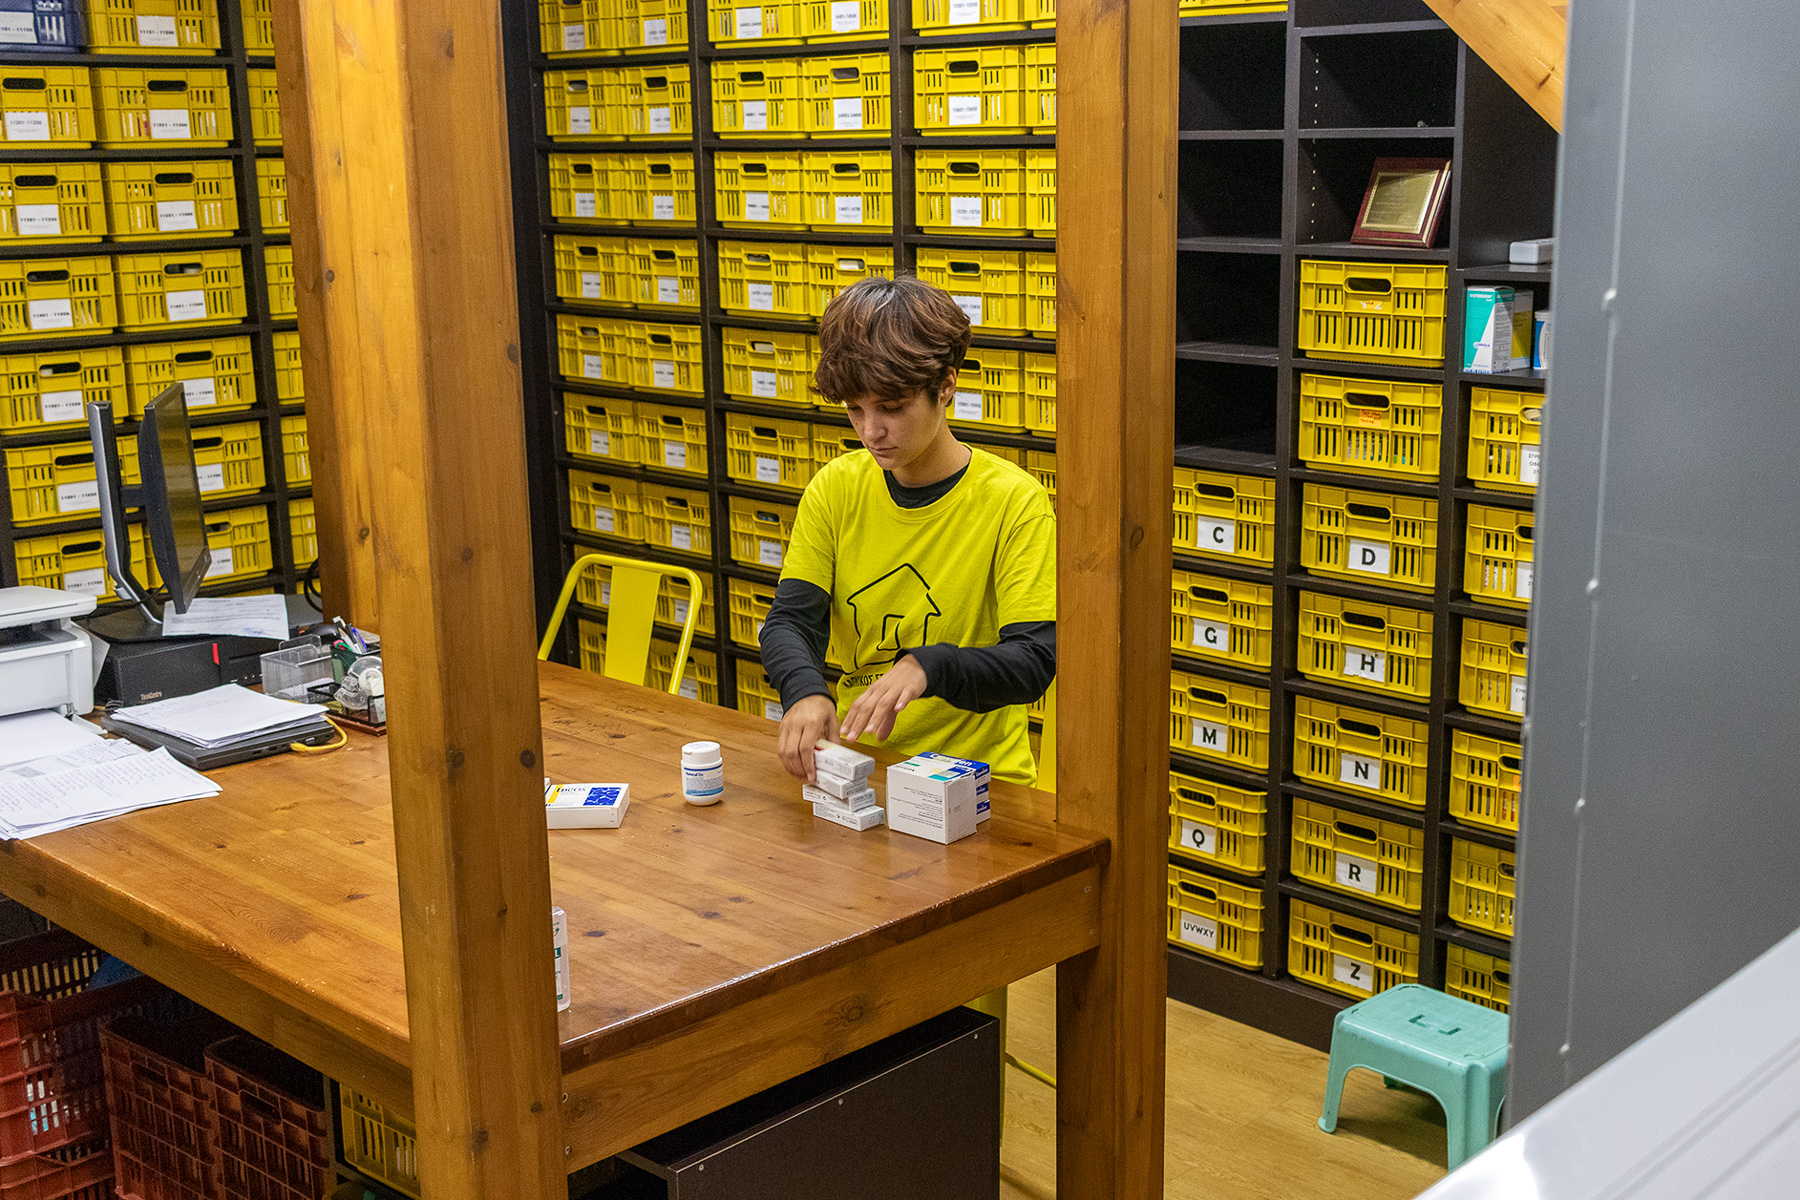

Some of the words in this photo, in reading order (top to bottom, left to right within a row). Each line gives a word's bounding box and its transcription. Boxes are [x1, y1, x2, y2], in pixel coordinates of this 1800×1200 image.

[1213, 527, 1224, 544] C
[1362, 548, 1376, 565] D
[1205, 626, 1218, 644] G
[1361, 654, 1375, 672] H
[1203, 727, 1217, 745] M
[1355, 761, 1369, 779] N
[1193, 829, 1205, 849] Q
[1349, 862, 1361, 882] R
[1183, 921, 1215, 938] UVWXY
[1350, 961, 1362, 980] Z
